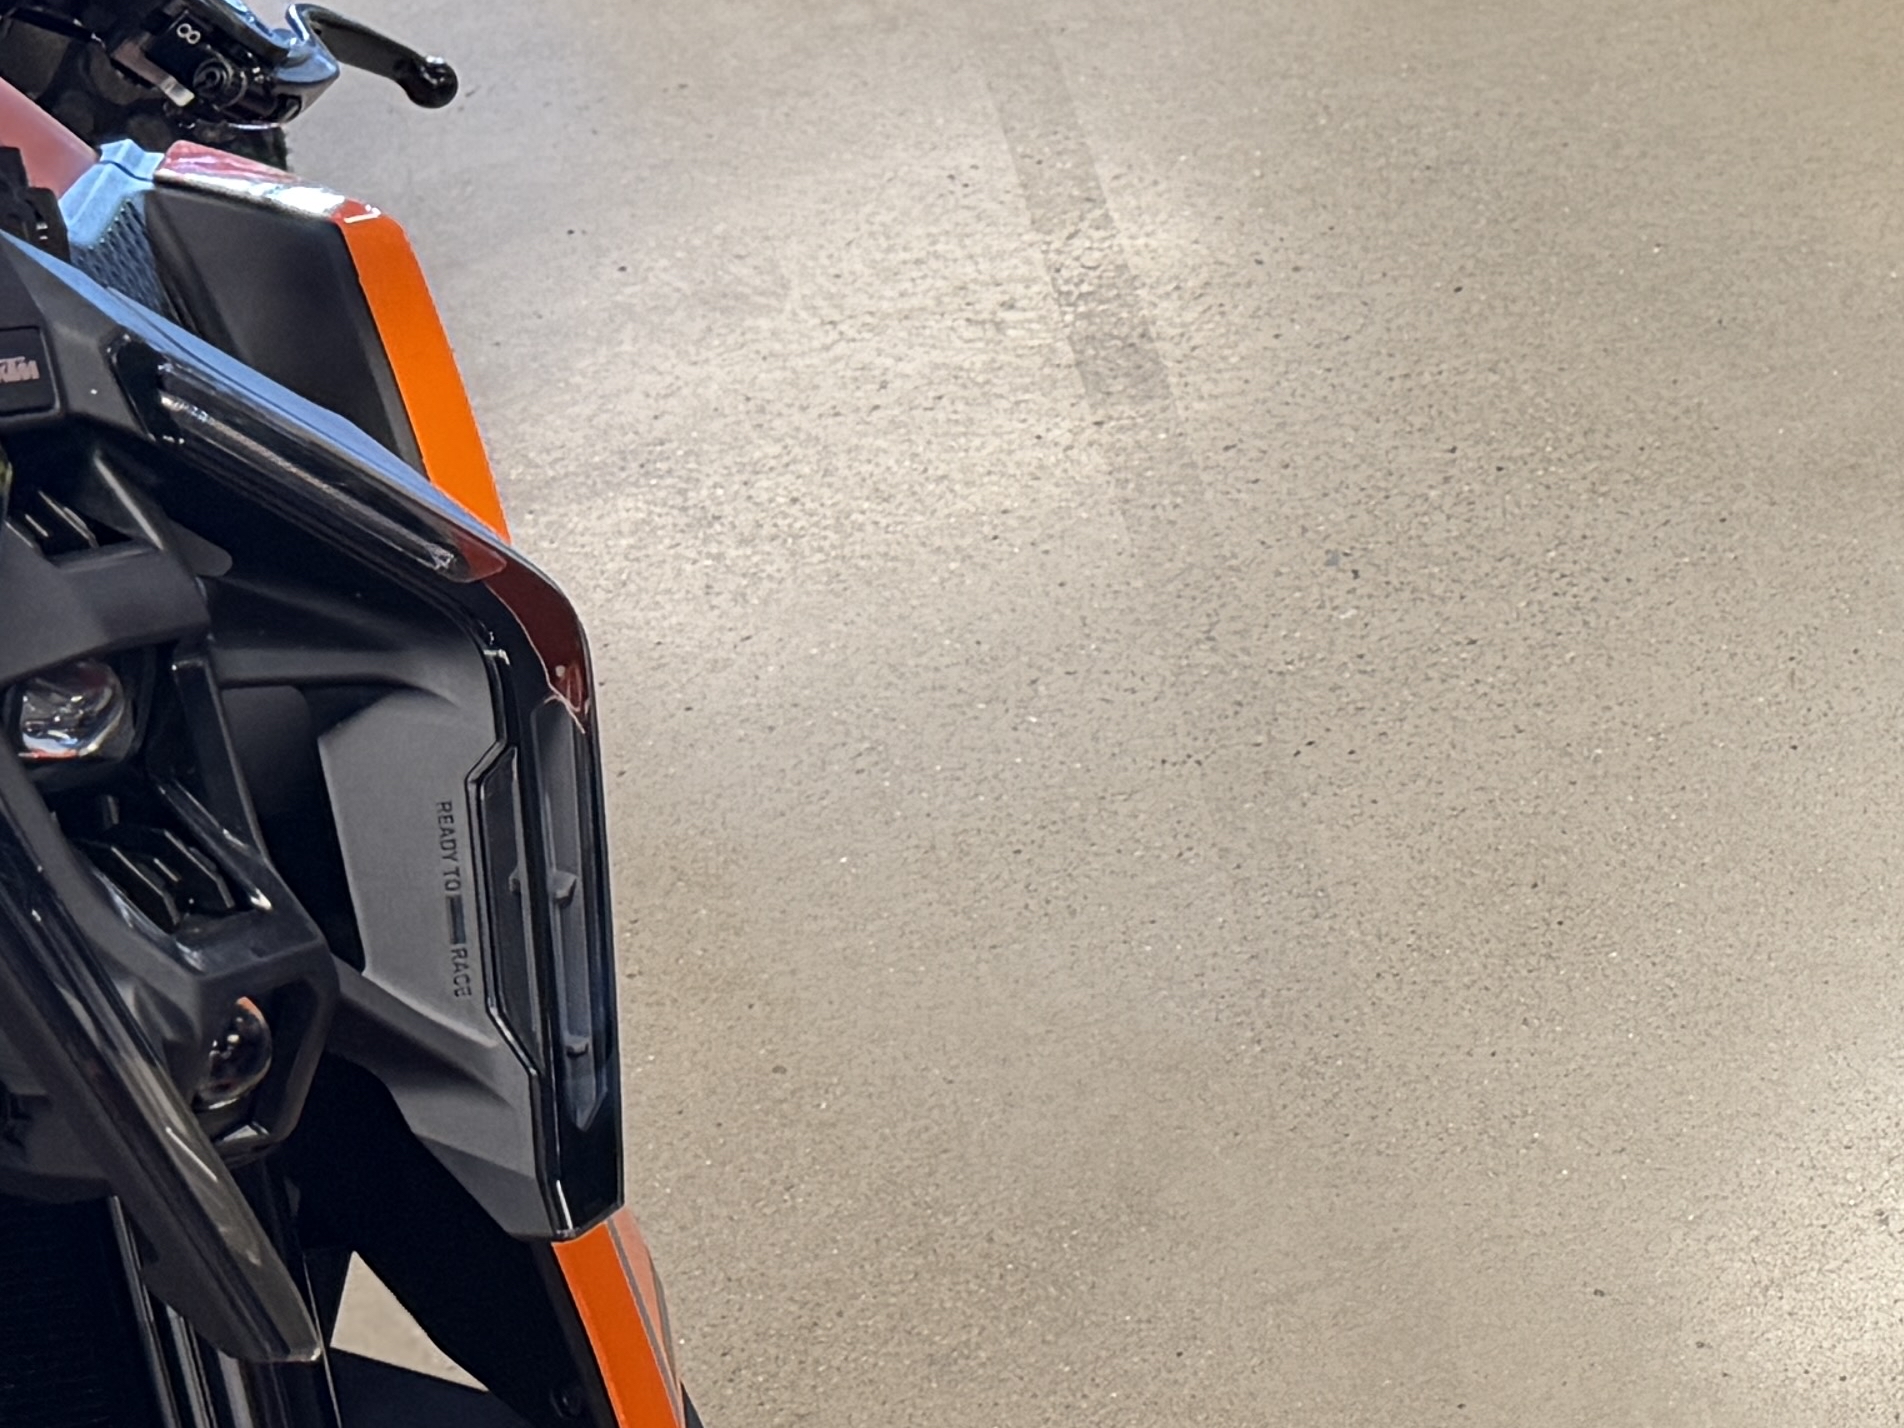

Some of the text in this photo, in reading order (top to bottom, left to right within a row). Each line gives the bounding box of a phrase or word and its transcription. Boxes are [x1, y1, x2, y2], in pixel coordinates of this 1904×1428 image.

[436, 801, 472, 998] READY TO RACE
